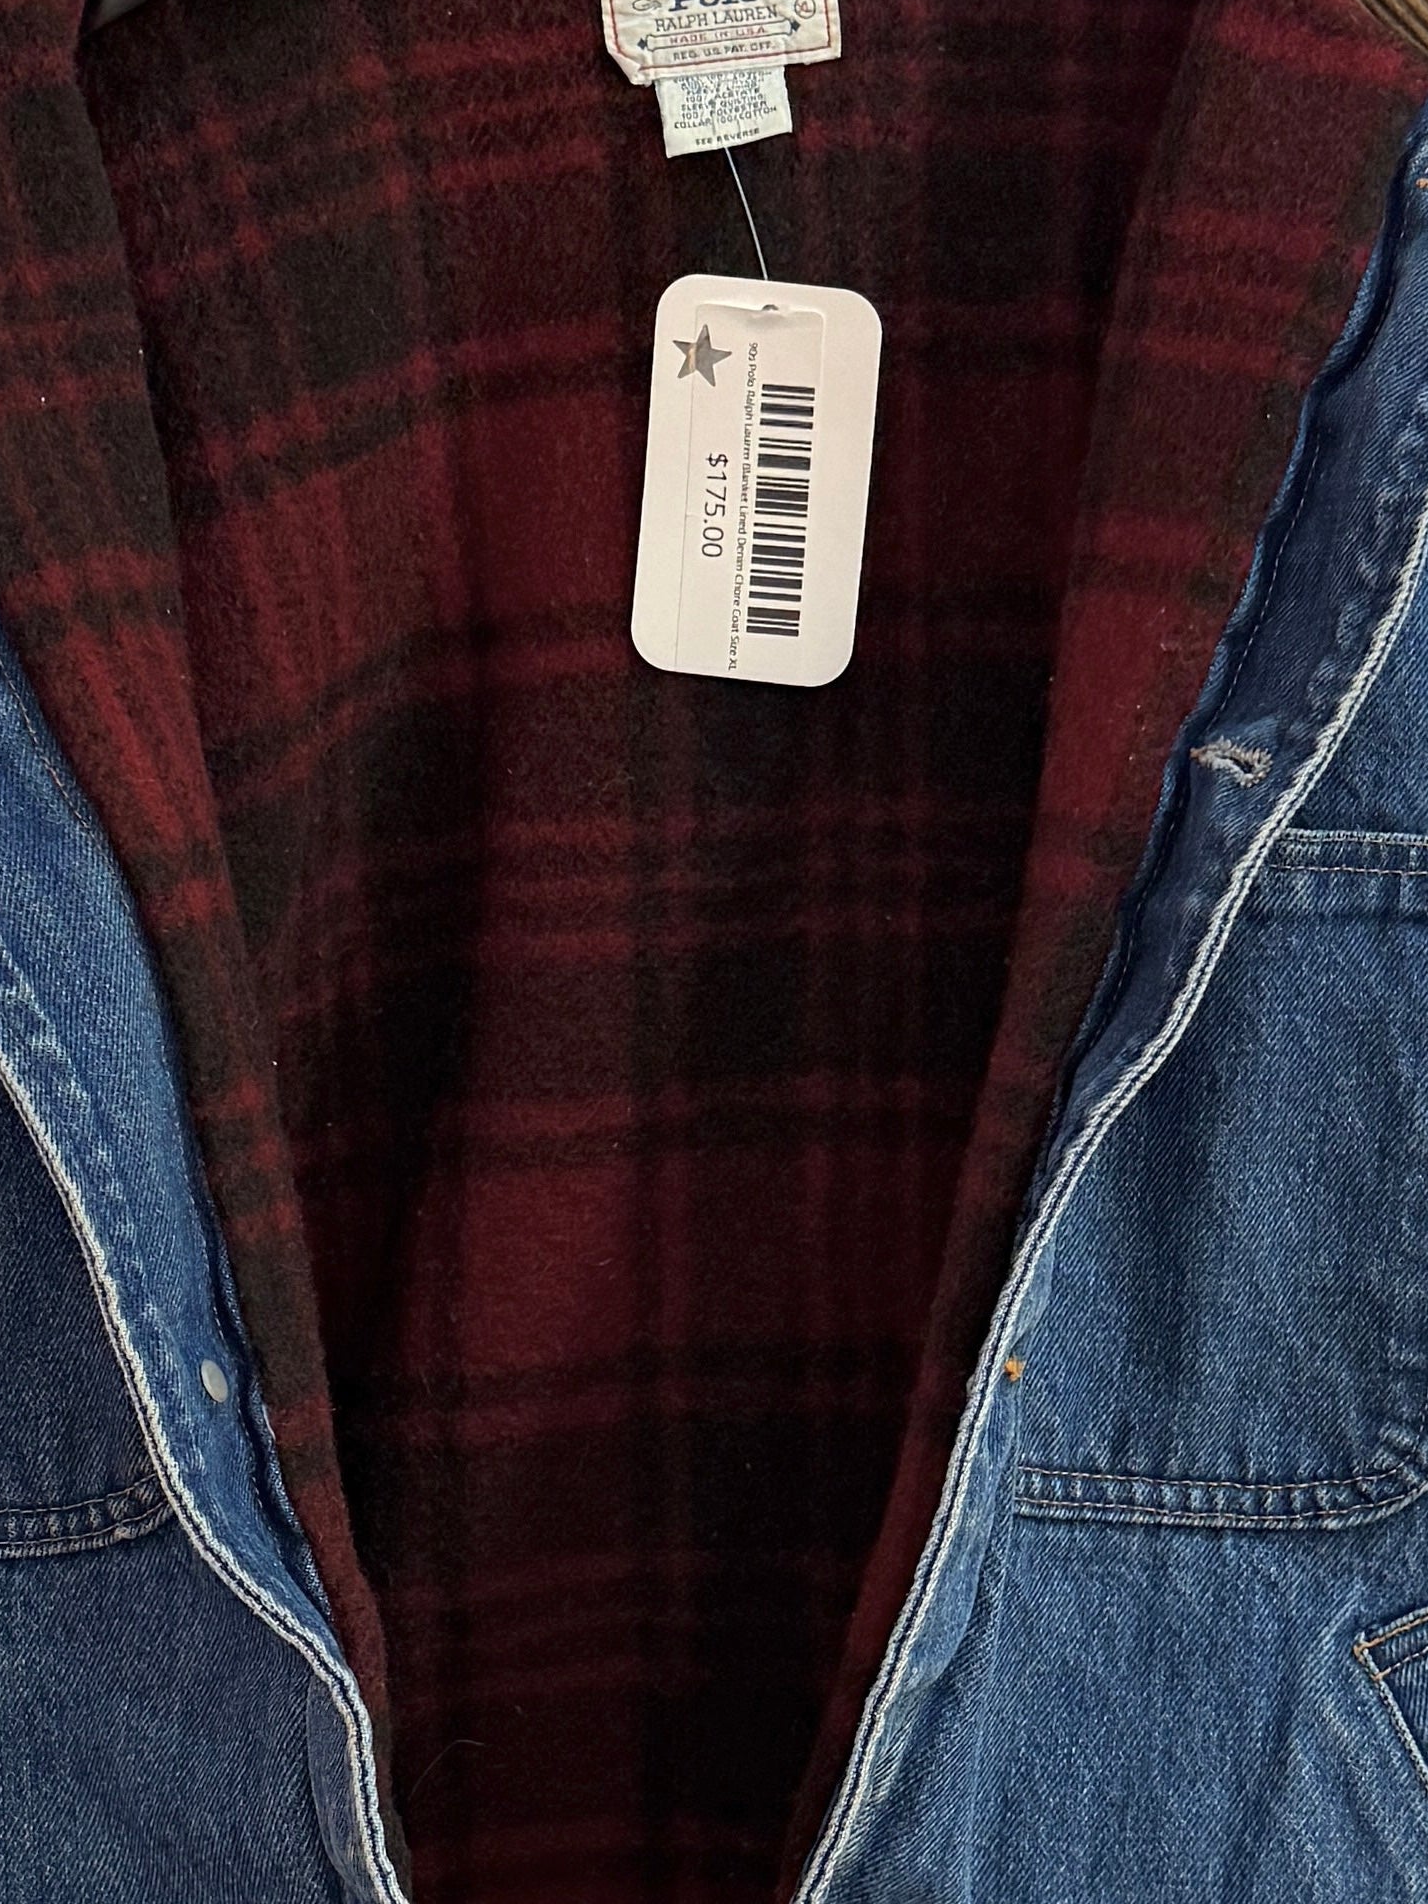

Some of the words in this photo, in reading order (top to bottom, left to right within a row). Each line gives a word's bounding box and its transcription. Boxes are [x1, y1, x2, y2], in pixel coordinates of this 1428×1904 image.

[655, 12, 709, 33] RALPH
[713, 4, 779, 26] LAUREN
[670, 32, 707, 45] MADE
[714, 29, 729, 39] IN
[701, 452, 729, 558] $175.00
[738, 505, 749, 536] Lined
[736, 538, 747, 572] Denim
[733, 573, 744, 607] Chore
[731, 609, 742, 634] Coat
